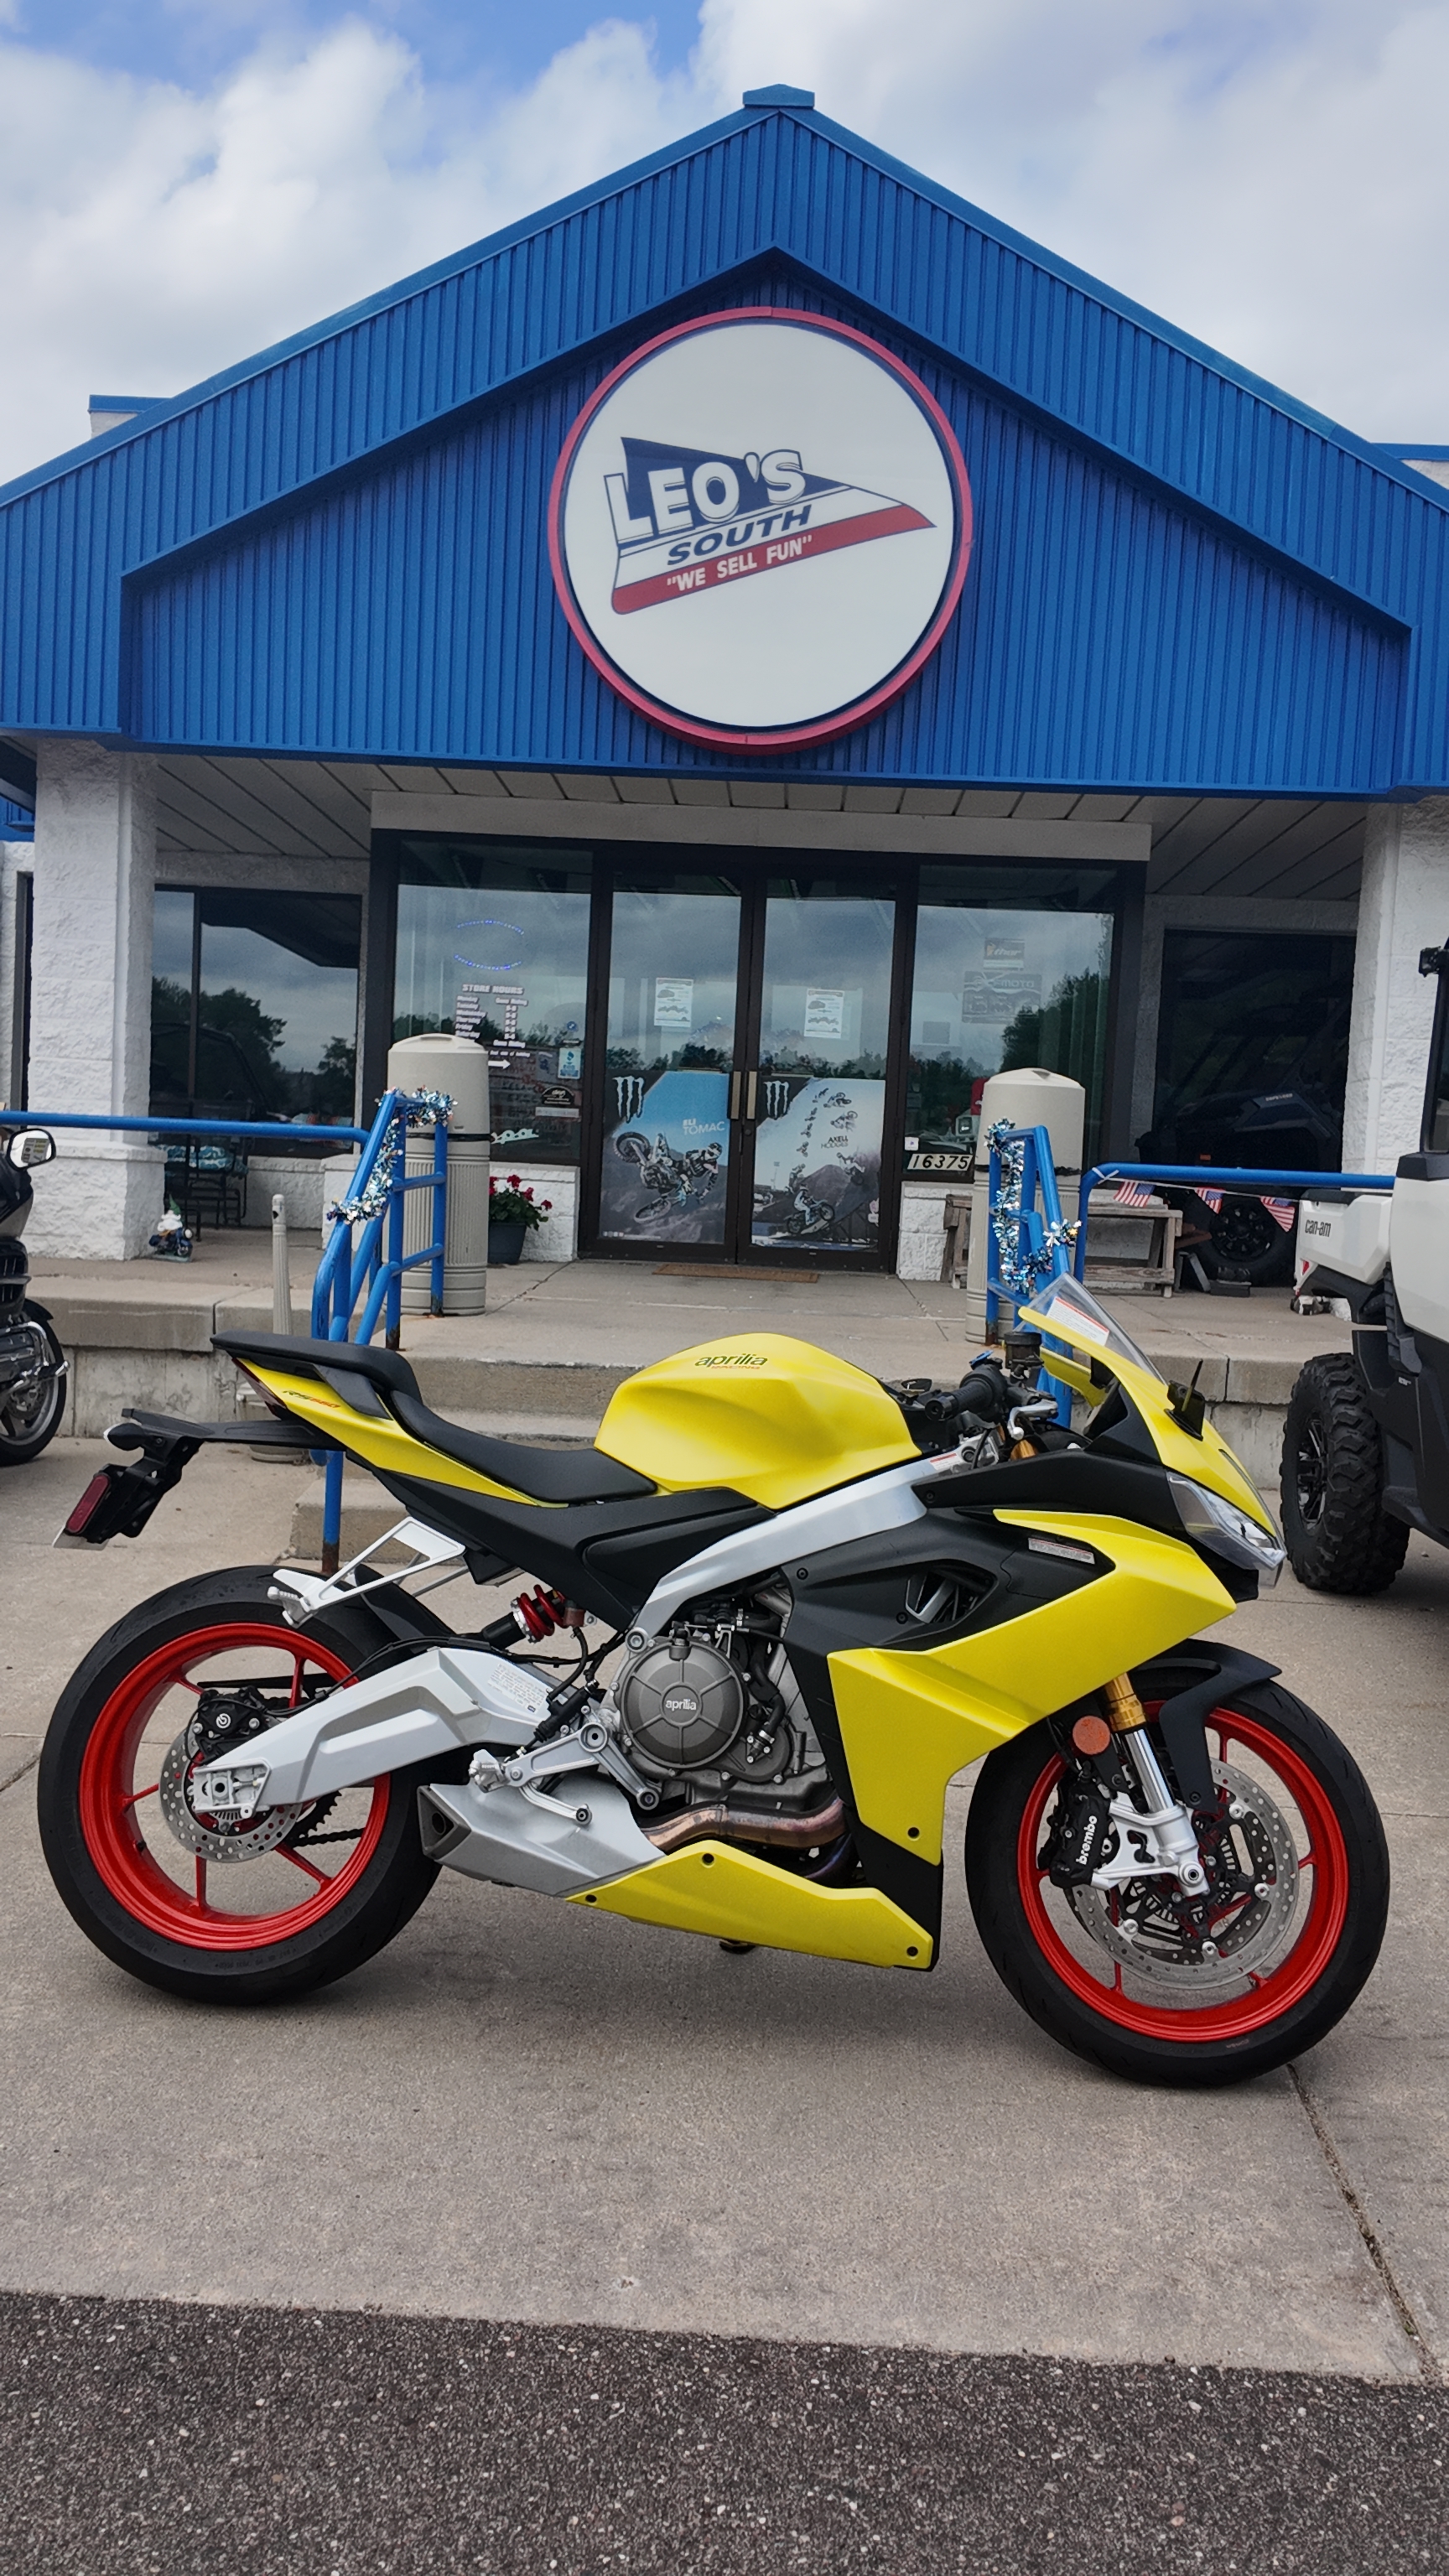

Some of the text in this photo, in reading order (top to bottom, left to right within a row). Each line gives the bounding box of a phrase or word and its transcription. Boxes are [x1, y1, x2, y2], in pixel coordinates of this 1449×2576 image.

[604, 449, 806, 544] LEO'S
[667, 504, 812, 565] SOUTH
[667, 535, 813, 591] "WE SELL FUN"
[462, 984, 524, 995] STORE HOURS
[683, 1120, 725, 1135] TOMAC
[913, 1155, 970, 1170] 16375
[1305, 1219, 1332, 1238] can-am
[694, 1353, 768, 1368] aprilia
[665, 1698, 697, 1711] aprilia
[1075, 1815, 1098, 1866] brembo
